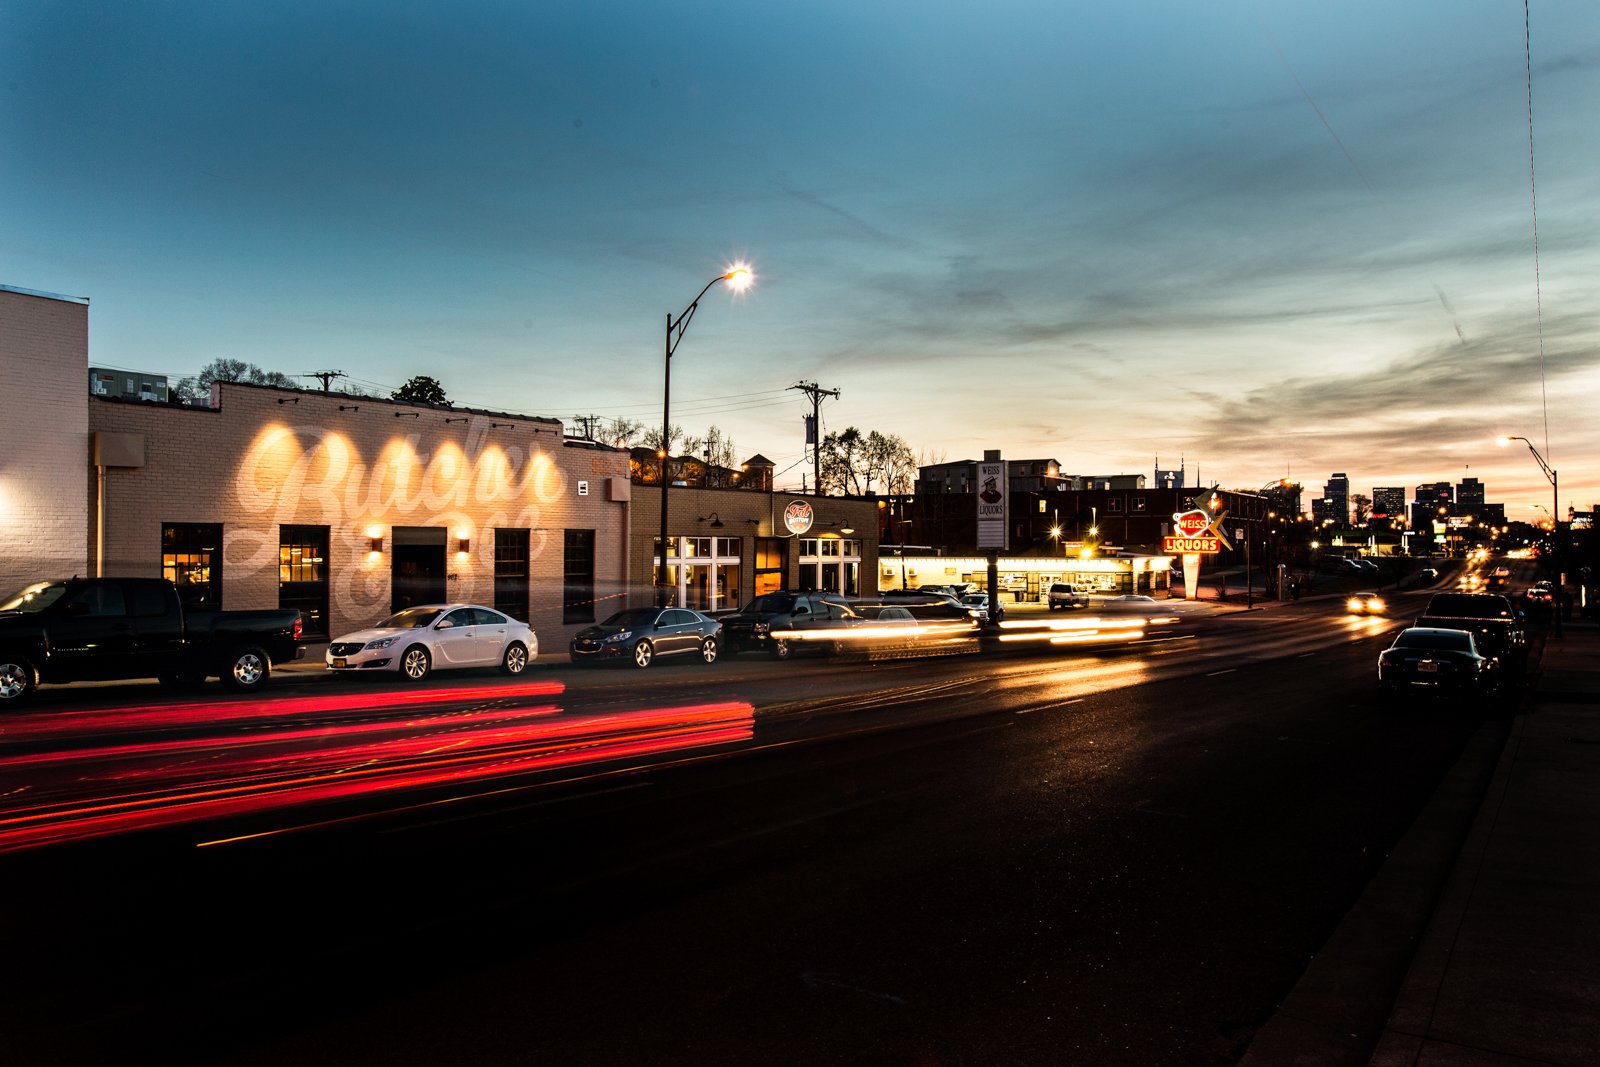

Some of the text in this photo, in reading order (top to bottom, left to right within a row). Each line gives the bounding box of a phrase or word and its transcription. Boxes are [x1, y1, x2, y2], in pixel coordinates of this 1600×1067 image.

[982, 465, 1000, 475] WEISS
[224, 416, 569, 580] Butcher
[787, 504, 811, 518] Fat
[979, 505, 1003, 516] LIQUORS
[1179, 519, 1206, 529] WEISS
[1166, 539, 1217, 551] LIQUORS
